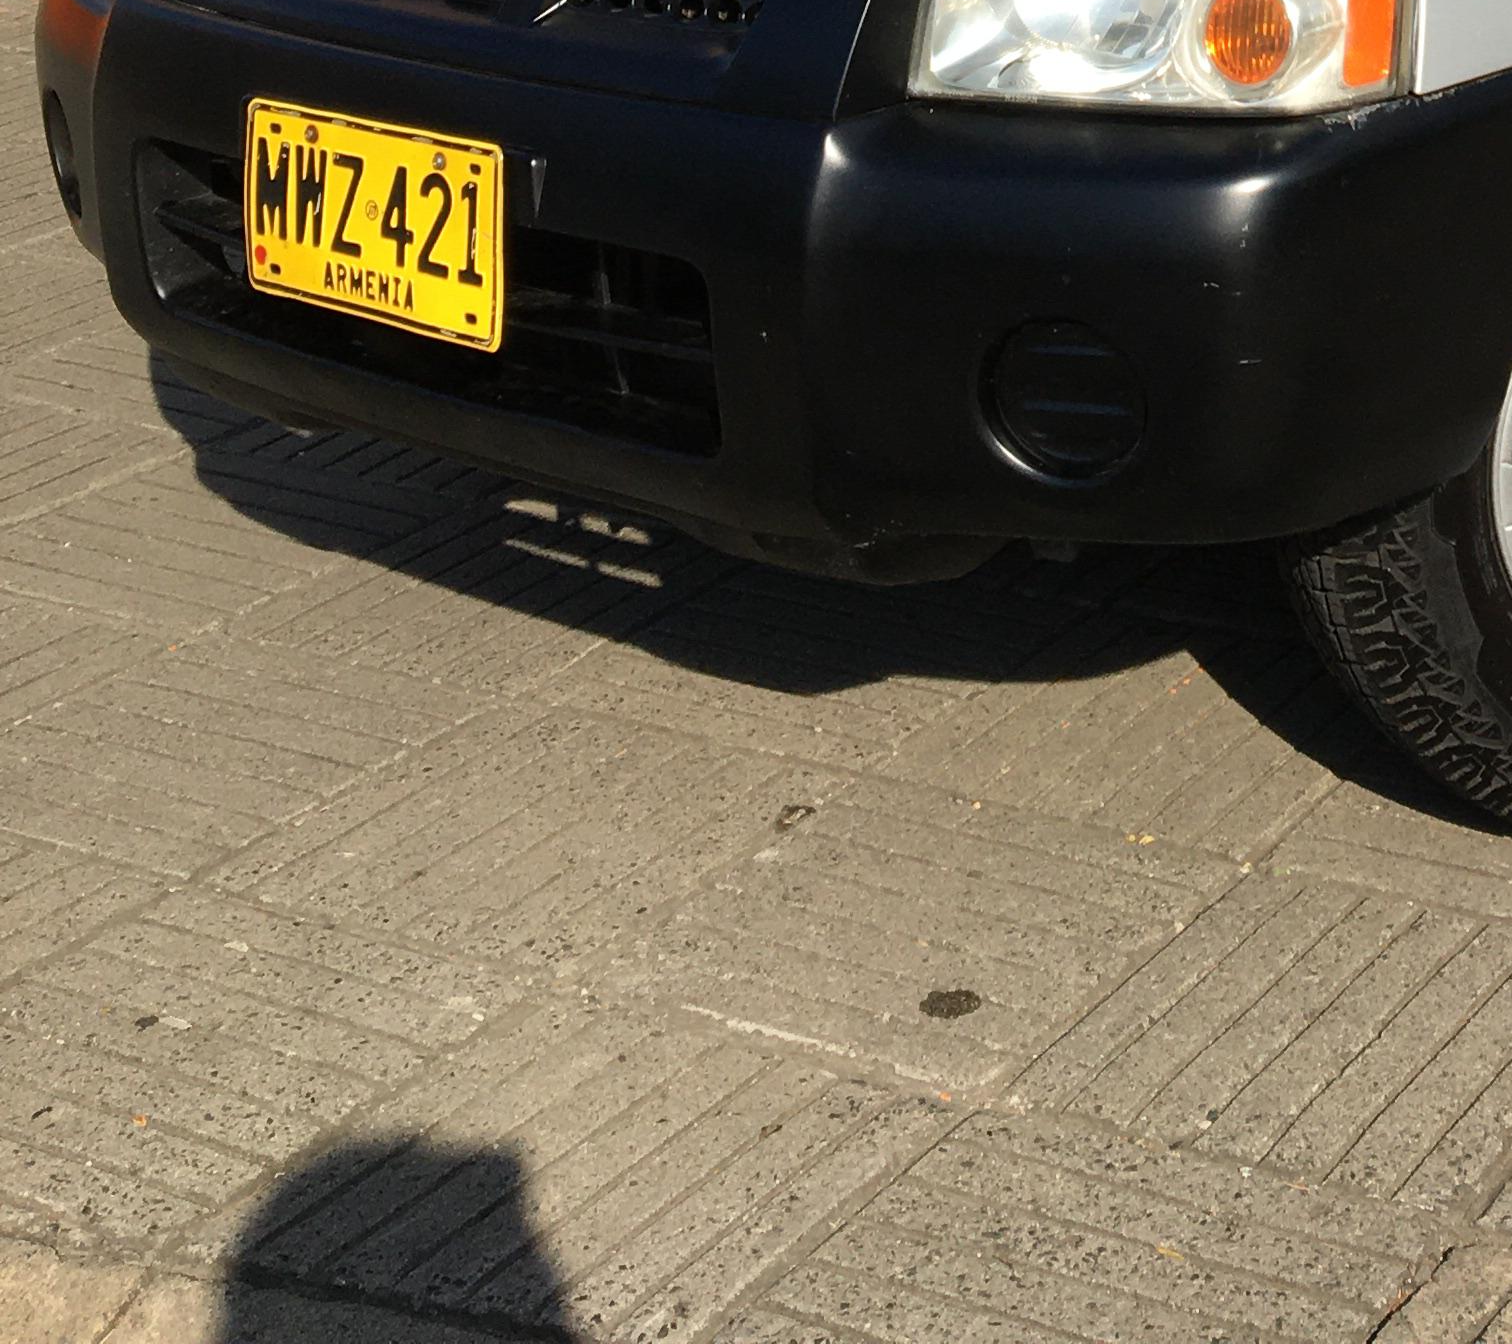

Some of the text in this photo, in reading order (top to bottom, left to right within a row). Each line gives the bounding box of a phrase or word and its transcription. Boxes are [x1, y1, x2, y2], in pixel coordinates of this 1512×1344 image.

[255, 135, 484, 288] MWZ 421
[324, 261, 416, 313] ARMENIA
